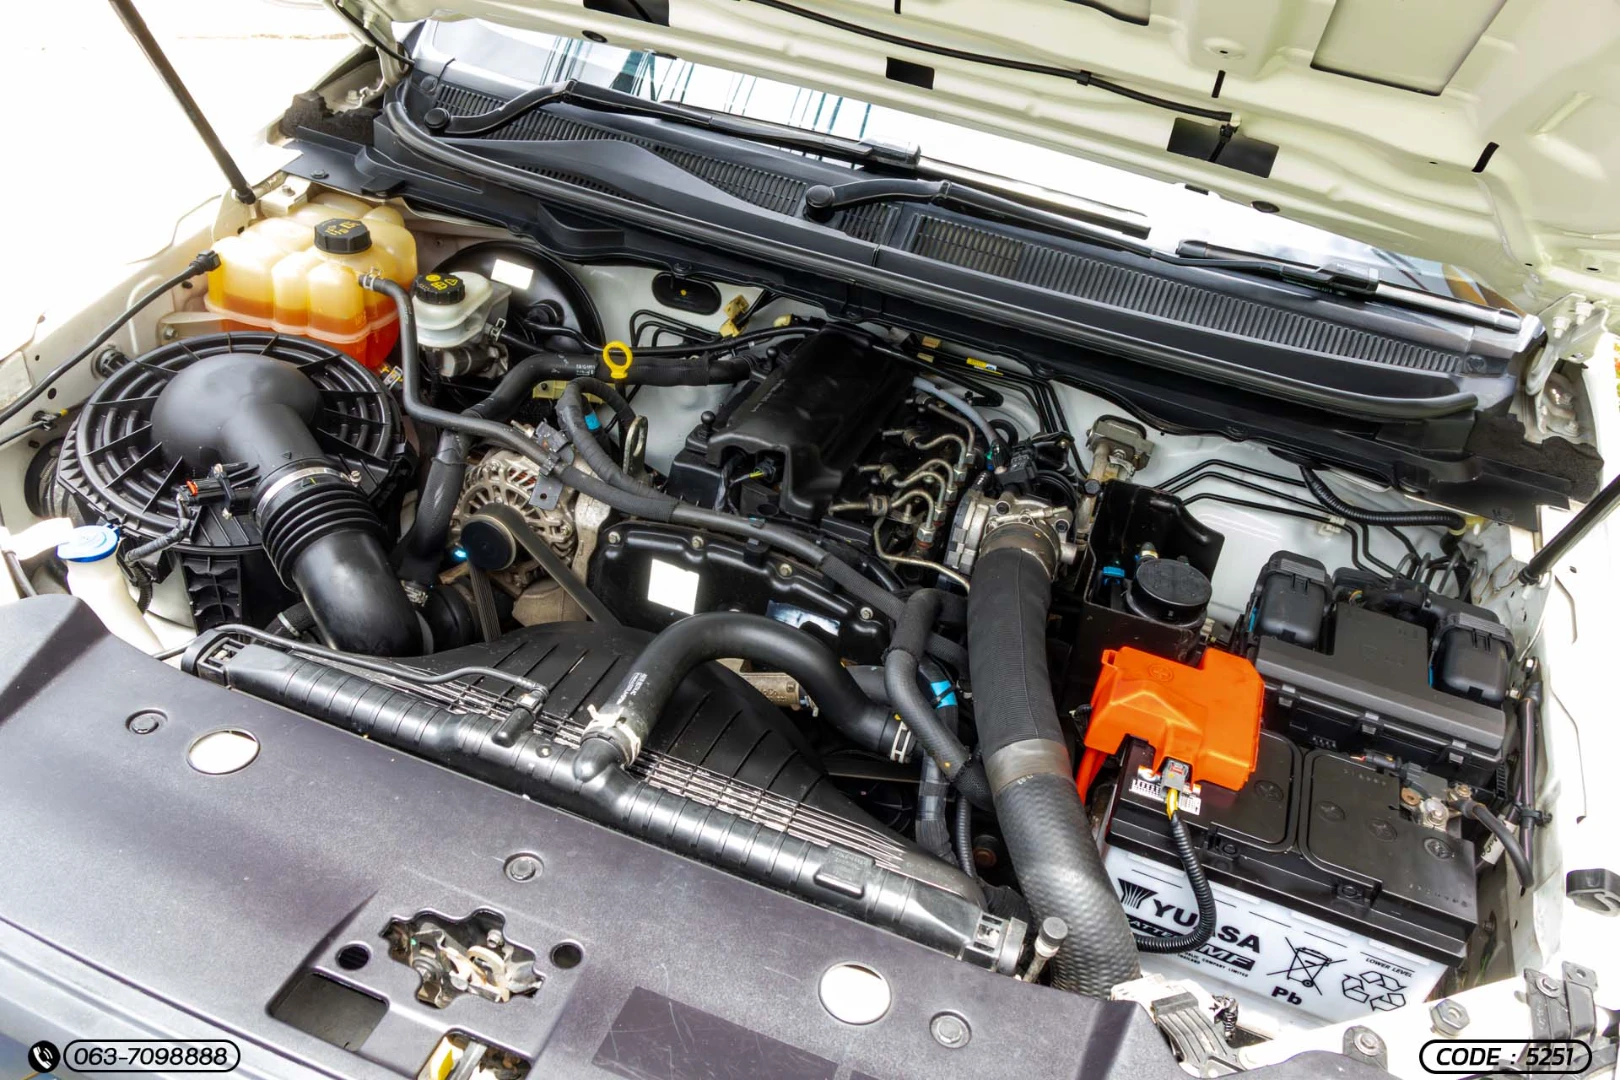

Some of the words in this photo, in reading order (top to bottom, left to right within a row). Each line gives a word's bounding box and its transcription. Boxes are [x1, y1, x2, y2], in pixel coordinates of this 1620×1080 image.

[1153, 899, 1260, 953] YUSA
[1199, 944, 1253, 963] MF
[1228, 968, 1249, 977] LIMITED
[1365, 958, 1390, 970] LOWER
[1392, 965, 1413, 978] LEVEL
[1271, 986, 1302, 1005] Pb
